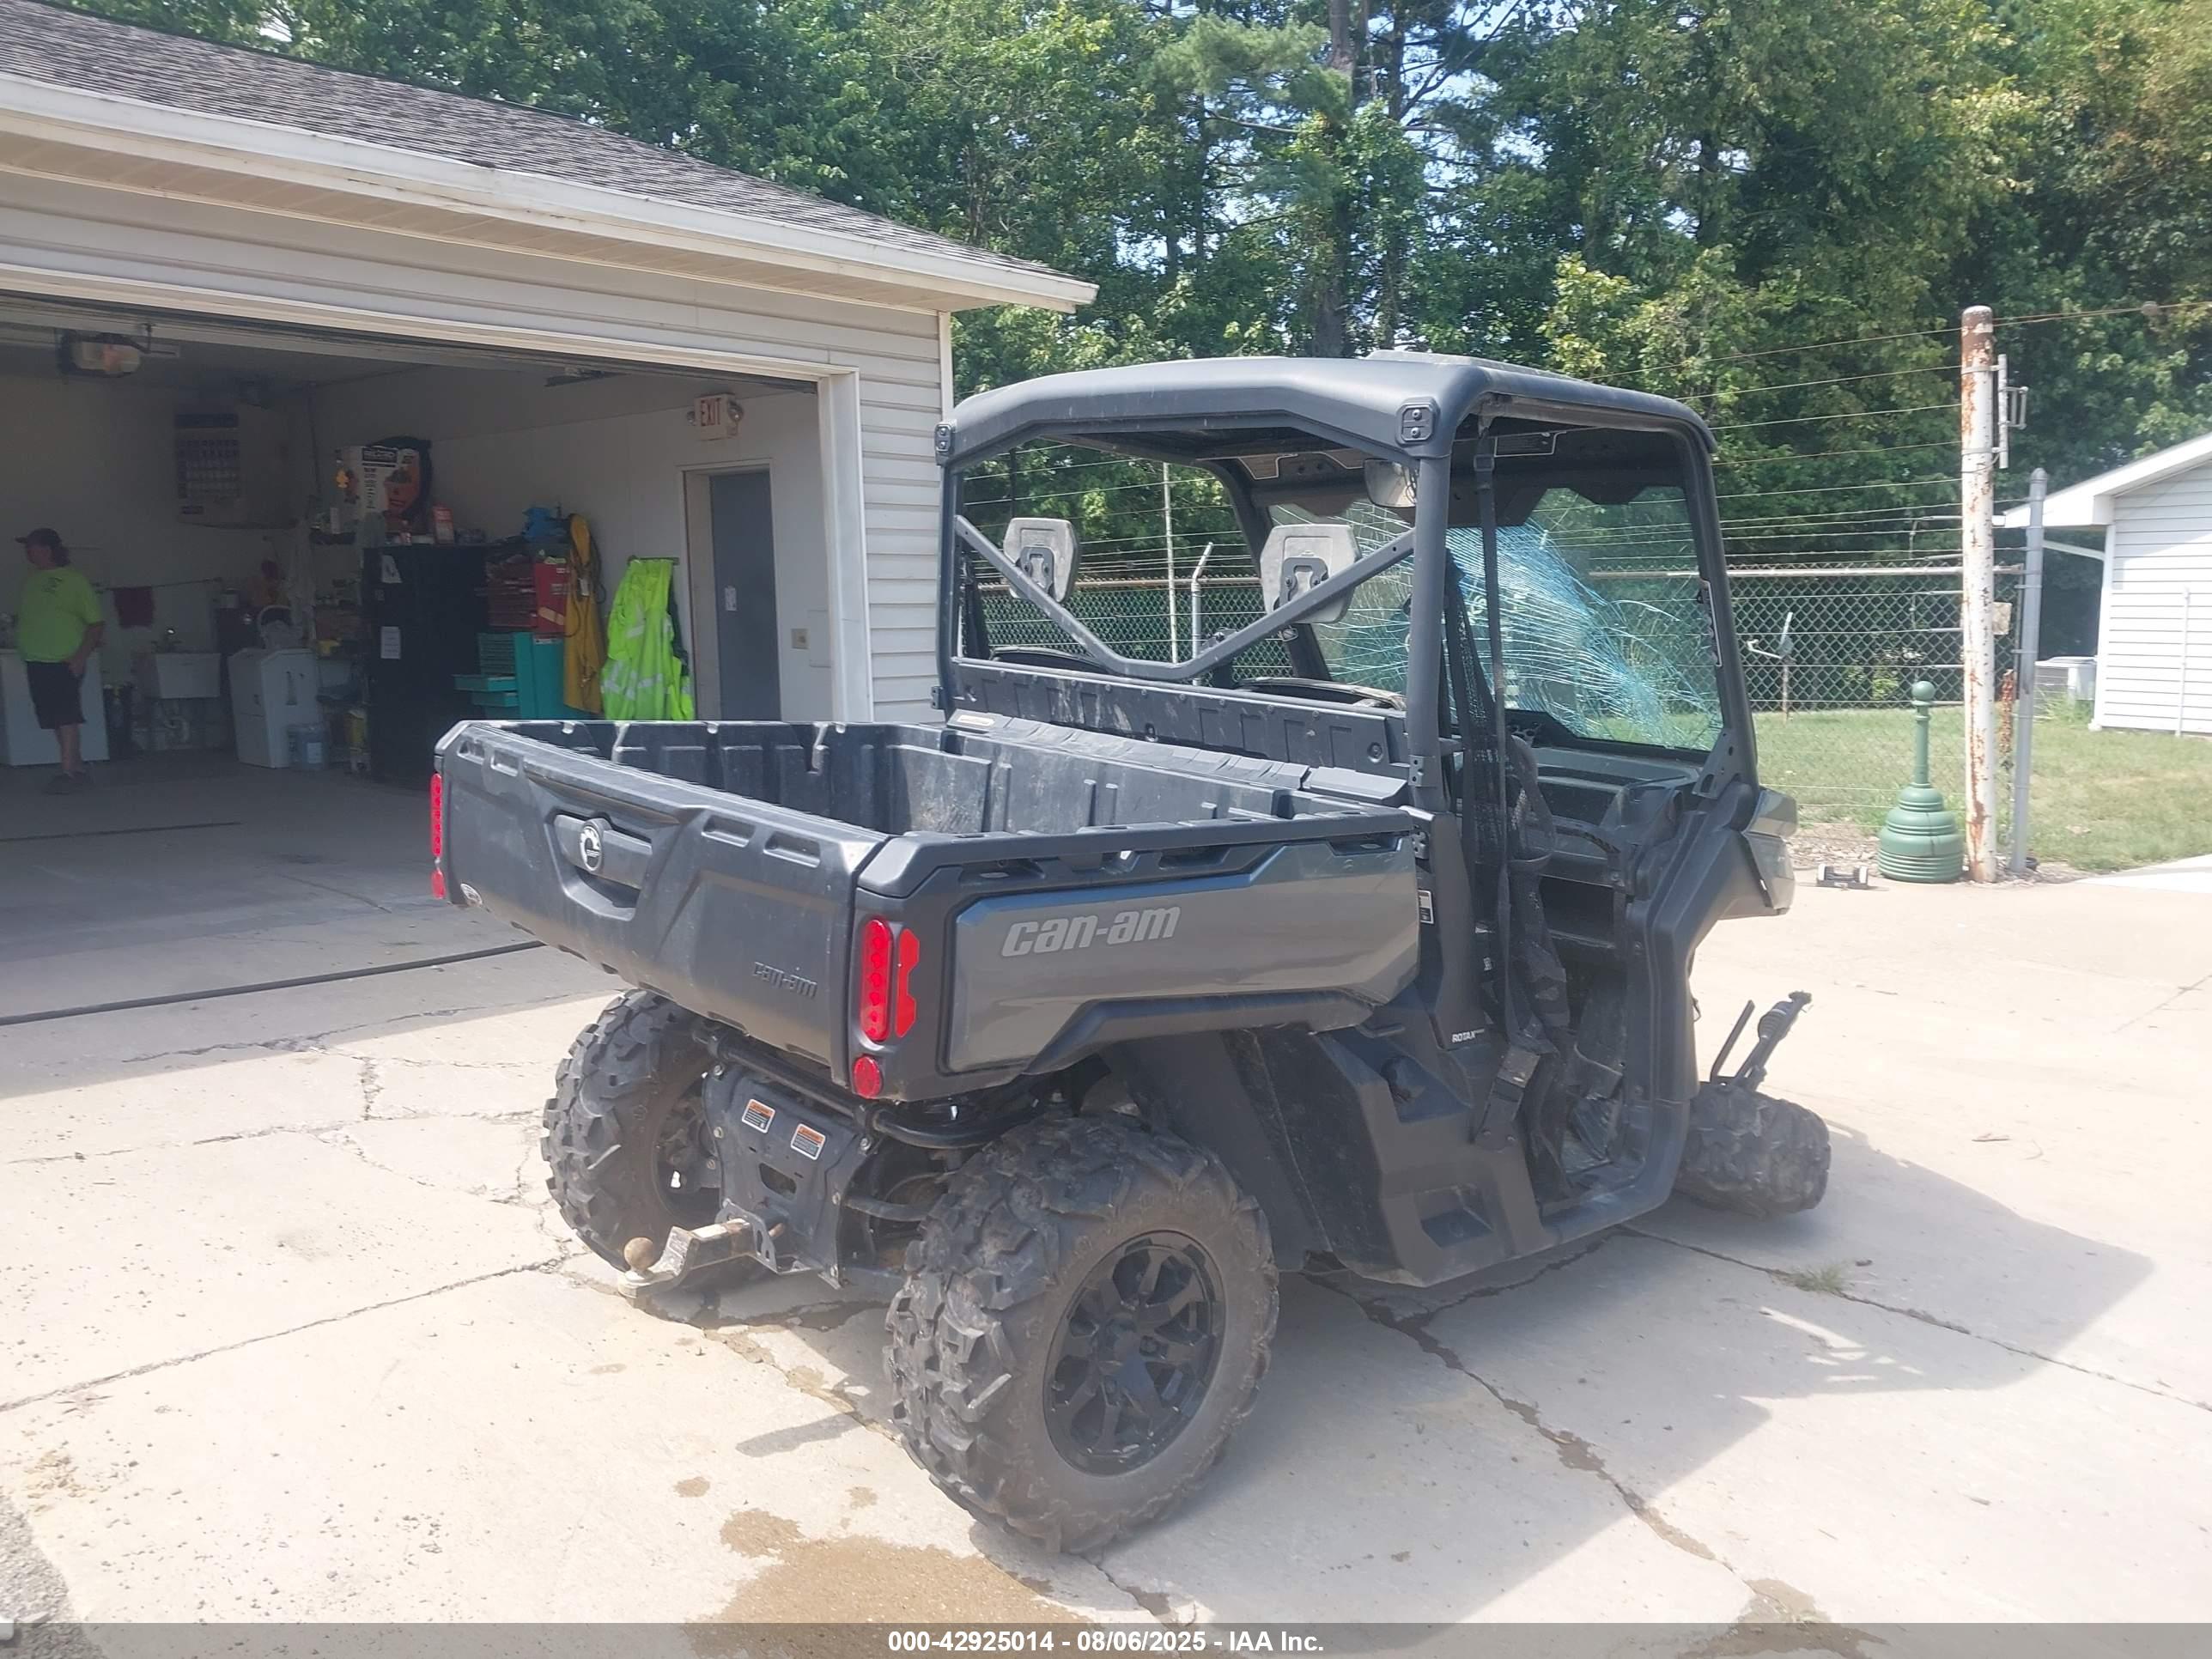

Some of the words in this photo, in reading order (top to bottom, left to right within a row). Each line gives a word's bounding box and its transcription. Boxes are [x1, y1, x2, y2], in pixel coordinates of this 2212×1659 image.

[700, 398, 722, 427] EXIT
[1001, 906, 1181, 957] can-am
[753, 961, 817, 999] can-am
[1451, 1031, 1476, 1043] ROTAX
